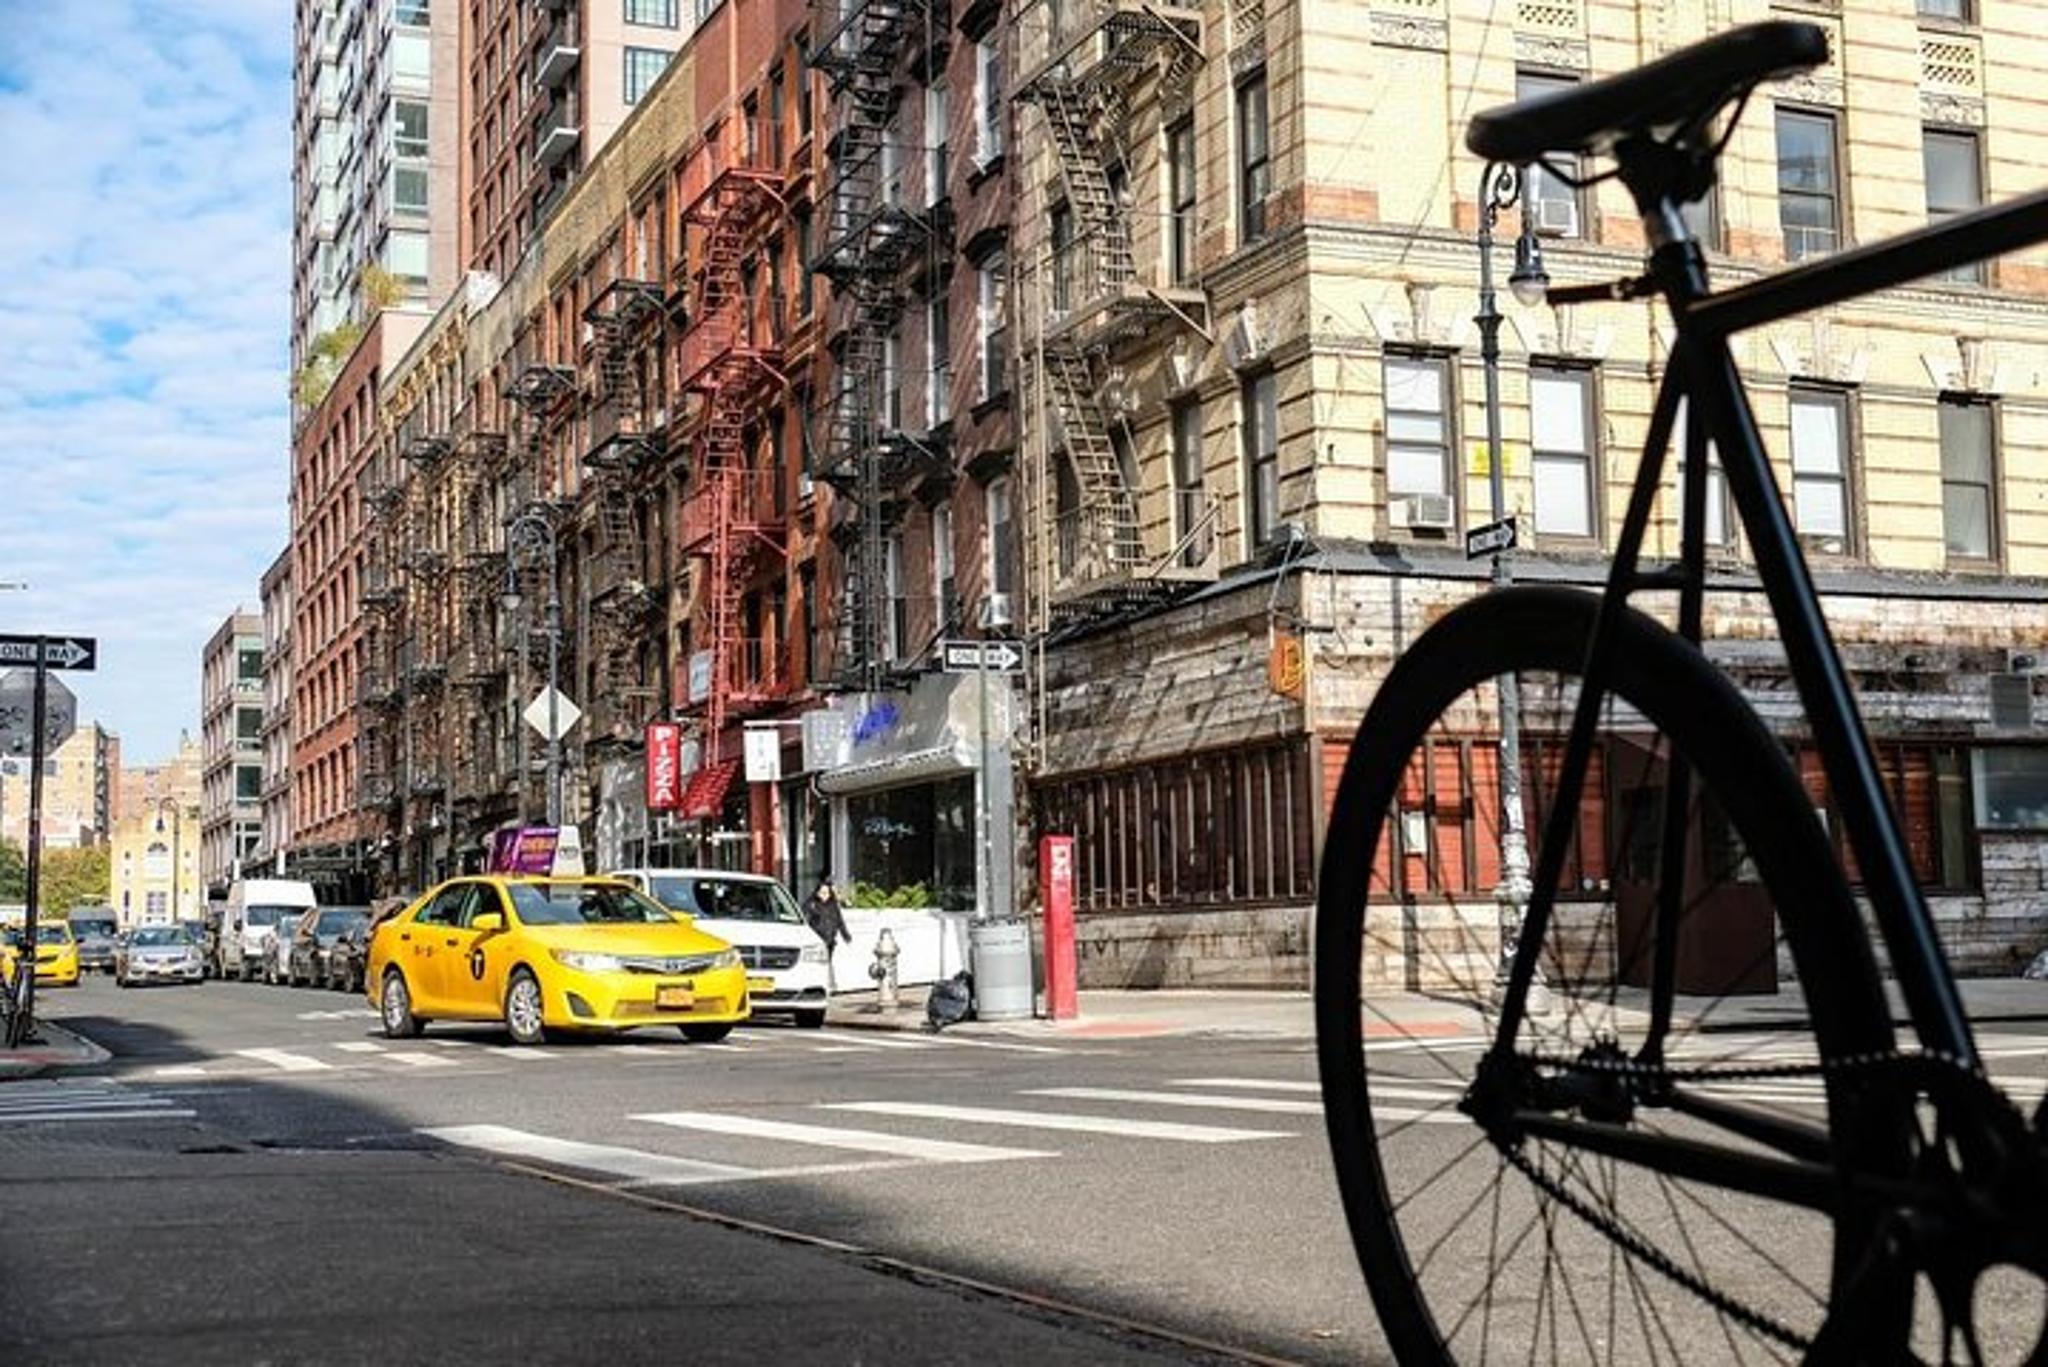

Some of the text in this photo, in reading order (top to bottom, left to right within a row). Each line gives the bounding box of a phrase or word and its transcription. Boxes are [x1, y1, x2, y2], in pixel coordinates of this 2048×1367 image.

[3, 645, 80, 660] ONE WAY
[953, 650, 1011, 663] ONE WAY
[654, 727, 674, 803] PIZZA
